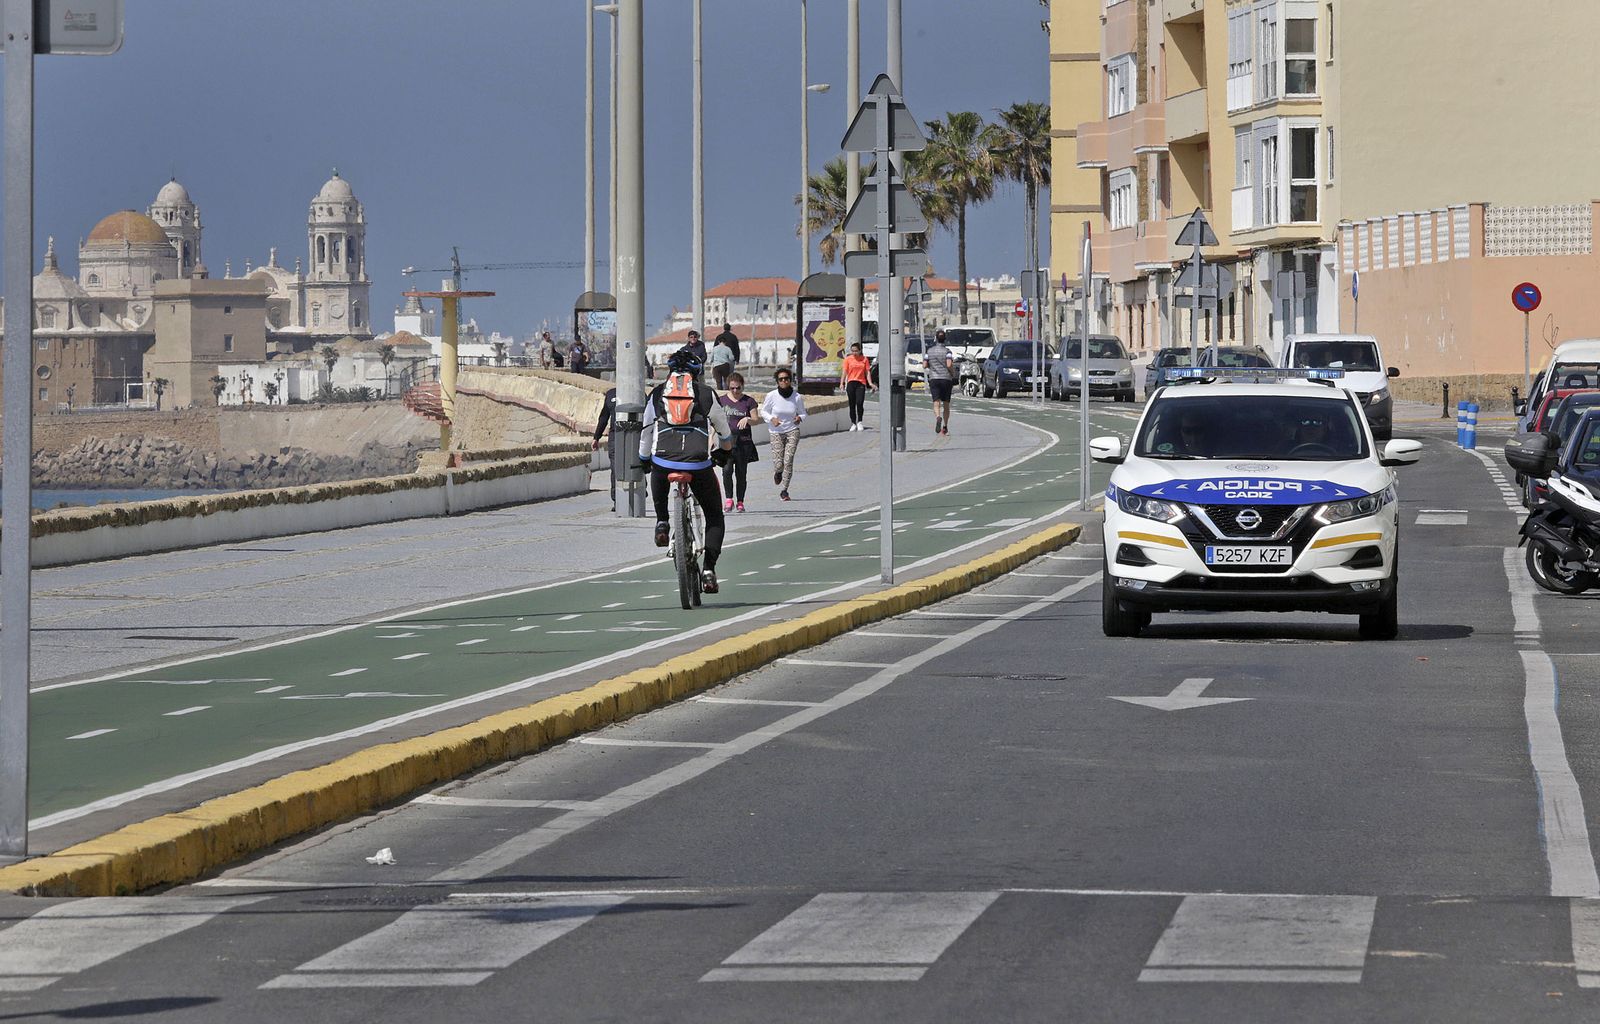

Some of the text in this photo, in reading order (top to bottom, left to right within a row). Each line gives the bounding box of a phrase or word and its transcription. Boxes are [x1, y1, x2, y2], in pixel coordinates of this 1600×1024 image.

[1225, 491, 1273, 499] CADIZ
[1216, 548, 1287, 562] 5257 KZF
